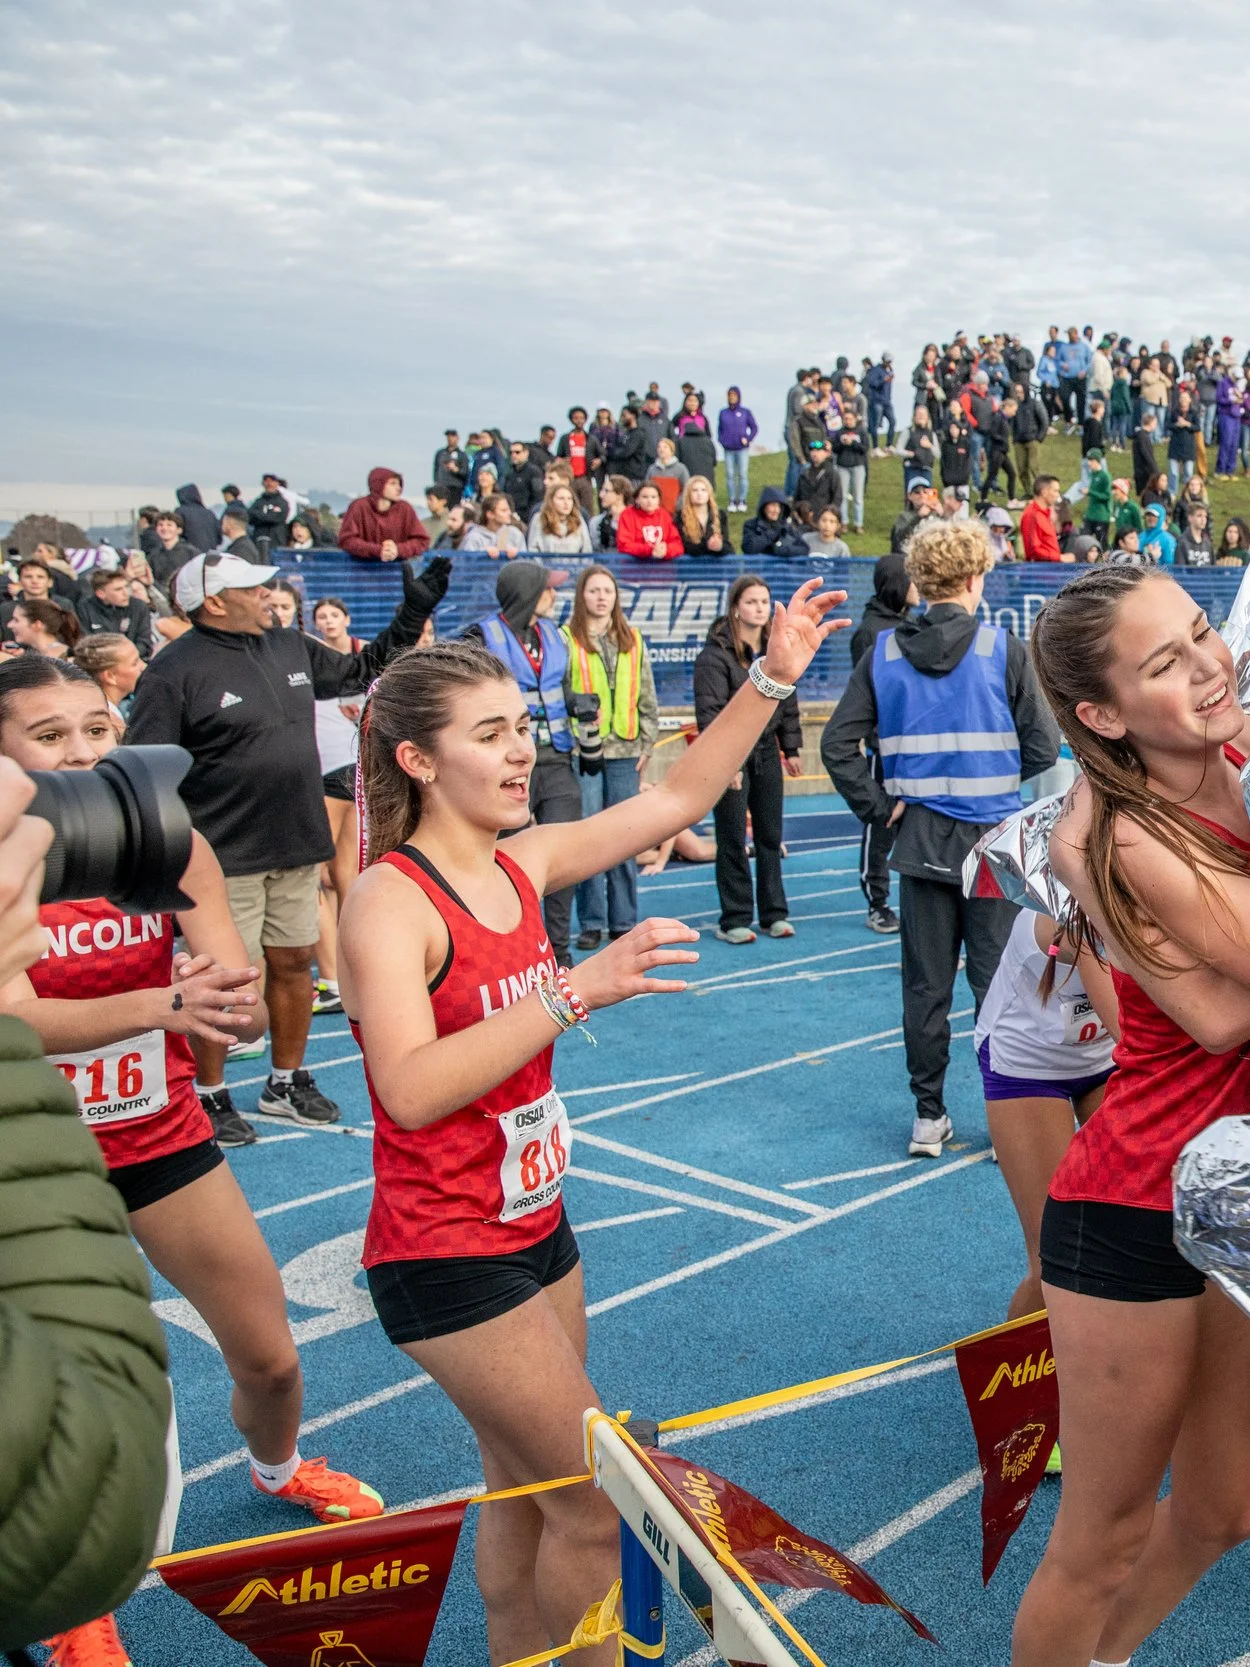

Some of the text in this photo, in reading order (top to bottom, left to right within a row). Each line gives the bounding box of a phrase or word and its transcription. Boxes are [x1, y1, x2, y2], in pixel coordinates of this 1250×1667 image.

[40, 912, 163, 959] NCOLN
[87, 1096, 151, 1117] COUNTRY
[515, 1104, 544, 1129] OSAA
[519, 1122, 566, 1192] 818
[513, 1190, 545, 1210] CROSS
[684, 1469, 733, 1553] thletic
[641, 1510, 671, 1566] GILL
[217, 1559, 430, 1616] Athletic
